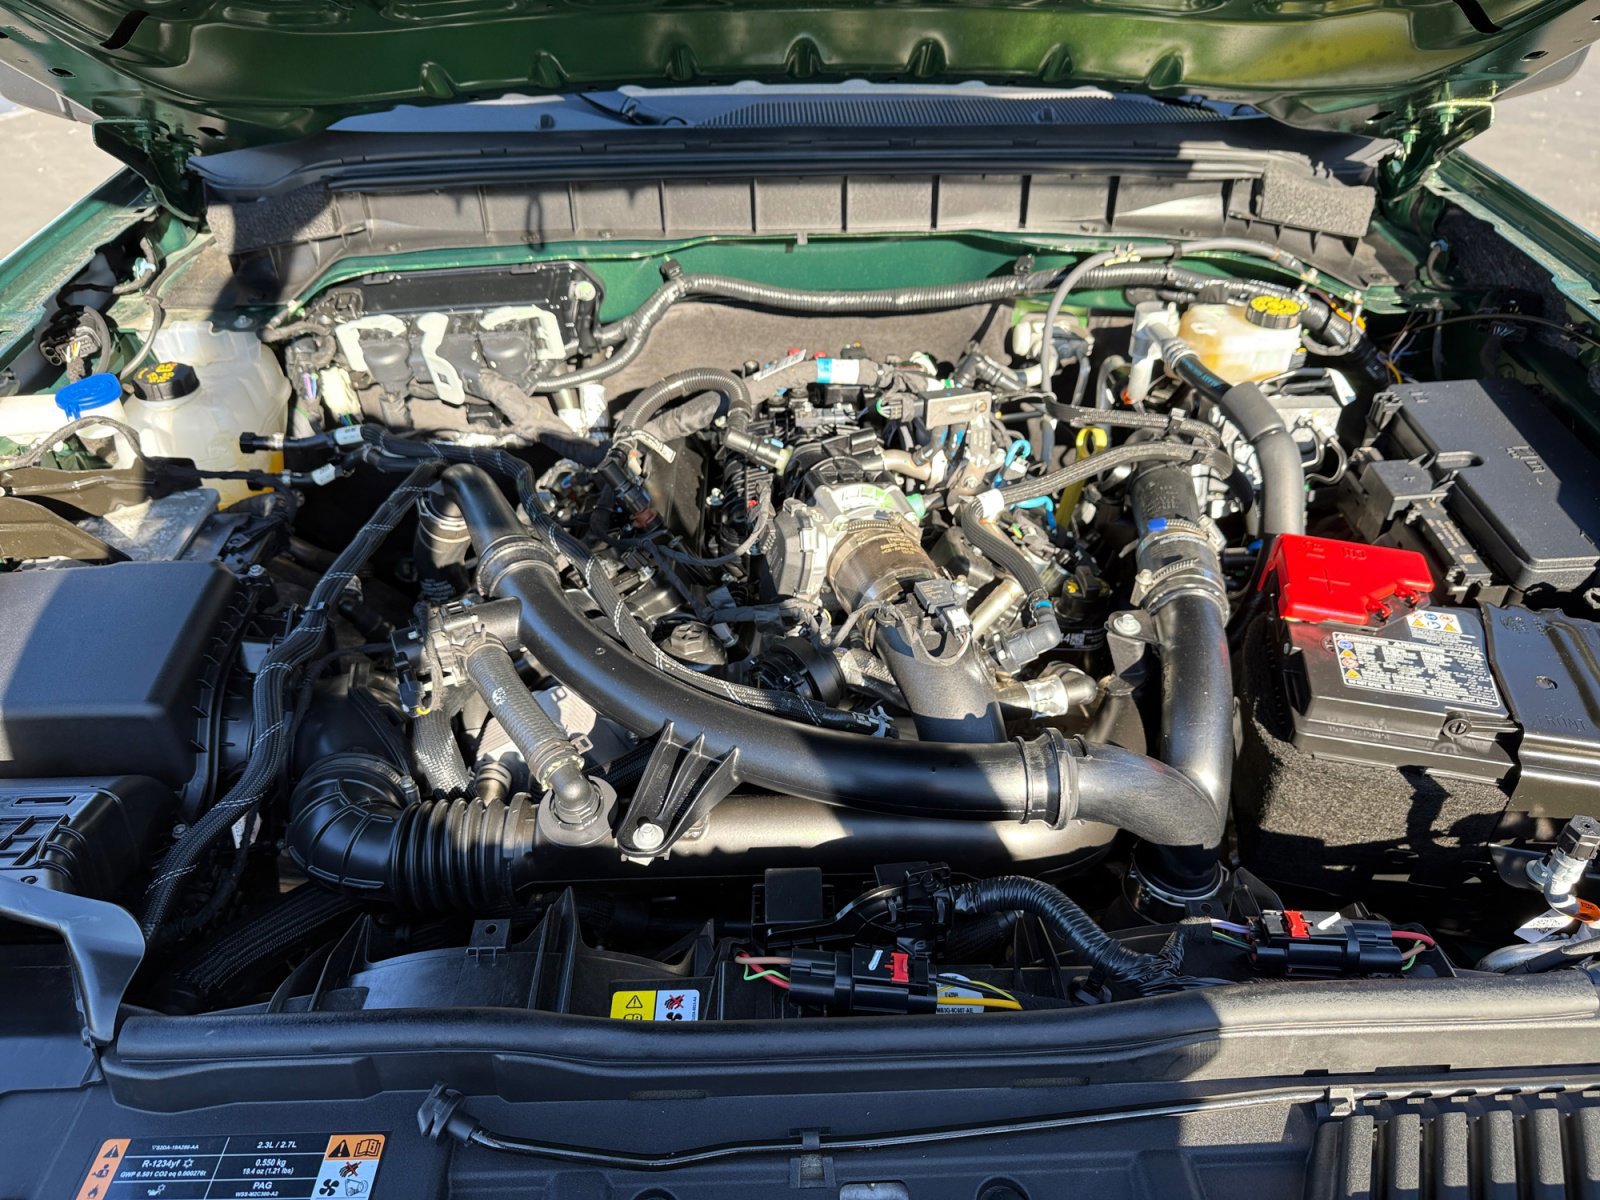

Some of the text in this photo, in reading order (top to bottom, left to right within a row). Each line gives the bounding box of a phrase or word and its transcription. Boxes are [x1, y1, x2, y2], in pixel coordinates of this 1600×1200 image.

[256, 1141, 274, 1149] 2.3L
[280, 1141, 297, 1149] 2.7L
[142, 1159, 181, 1169] R-1234yf
[255, 1158, 287, 1168] 0.550 kg
[264, 1167, 280, 1176] (1.21
[281, 1166, 294, 1176] lbs)
[252, 1181, 273, 1190] PAG
